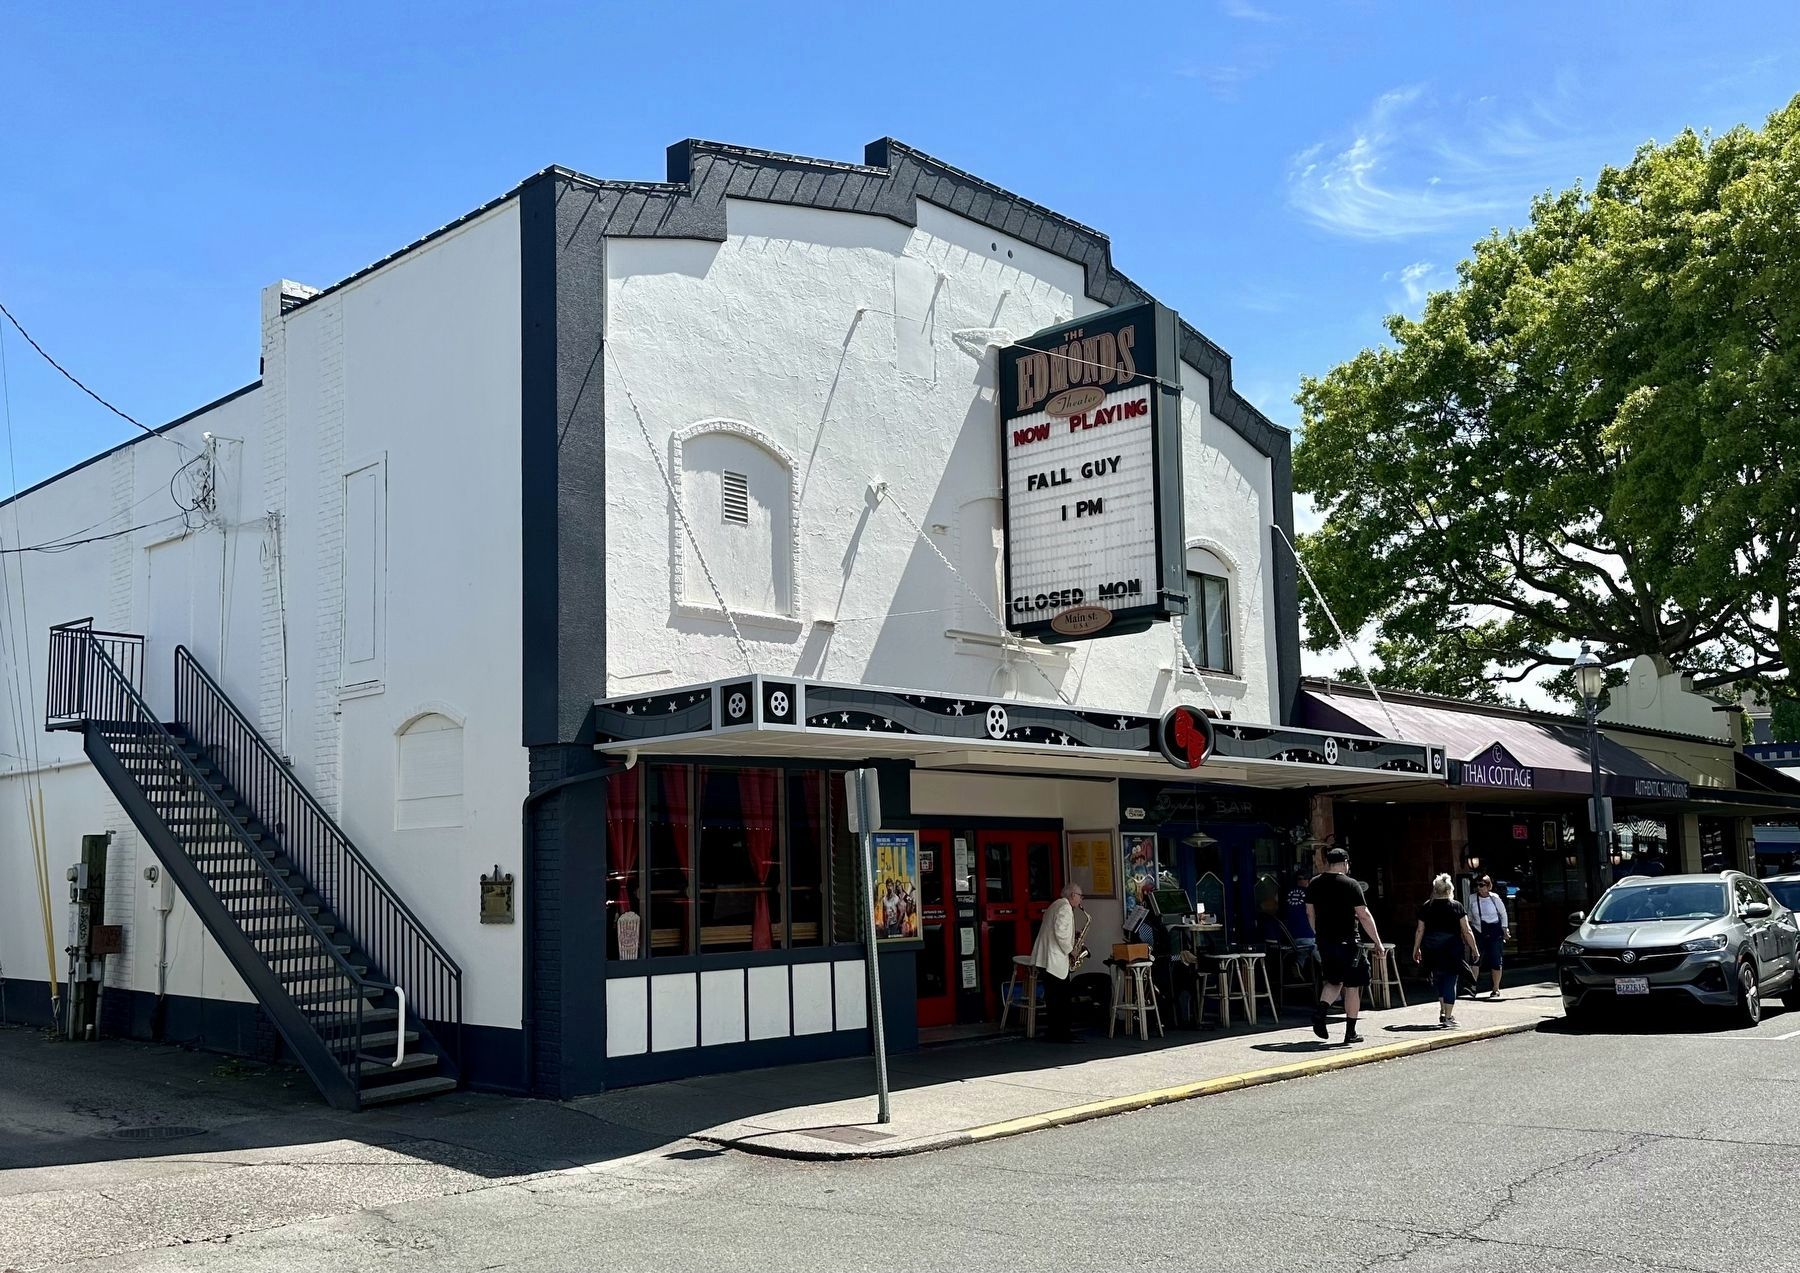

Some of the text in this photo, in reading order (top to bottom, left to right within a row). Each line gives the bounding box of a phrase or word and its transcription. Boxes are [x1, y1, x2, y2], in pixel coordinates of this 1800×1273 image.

[1064, 328, 1084, 341] THE
[1015, 325, 1136, 412] EDMONDS
[1057, 394, 1098, 411] Theater
[1013, 398, 1148, 446] NOW PLAYING
[1028, 455, 1121, 491] FALL GUY
[1076, 497, 1103, 518] PM
[1013, 578, 1141, 612] CLOSED MON
[1065, 614, 1086, 625] Main
[1463, 763, 1532, 787] THAI COTTAGE
[1635, 779, 1688, 799] AUTHENTIC THAI CUISINE
